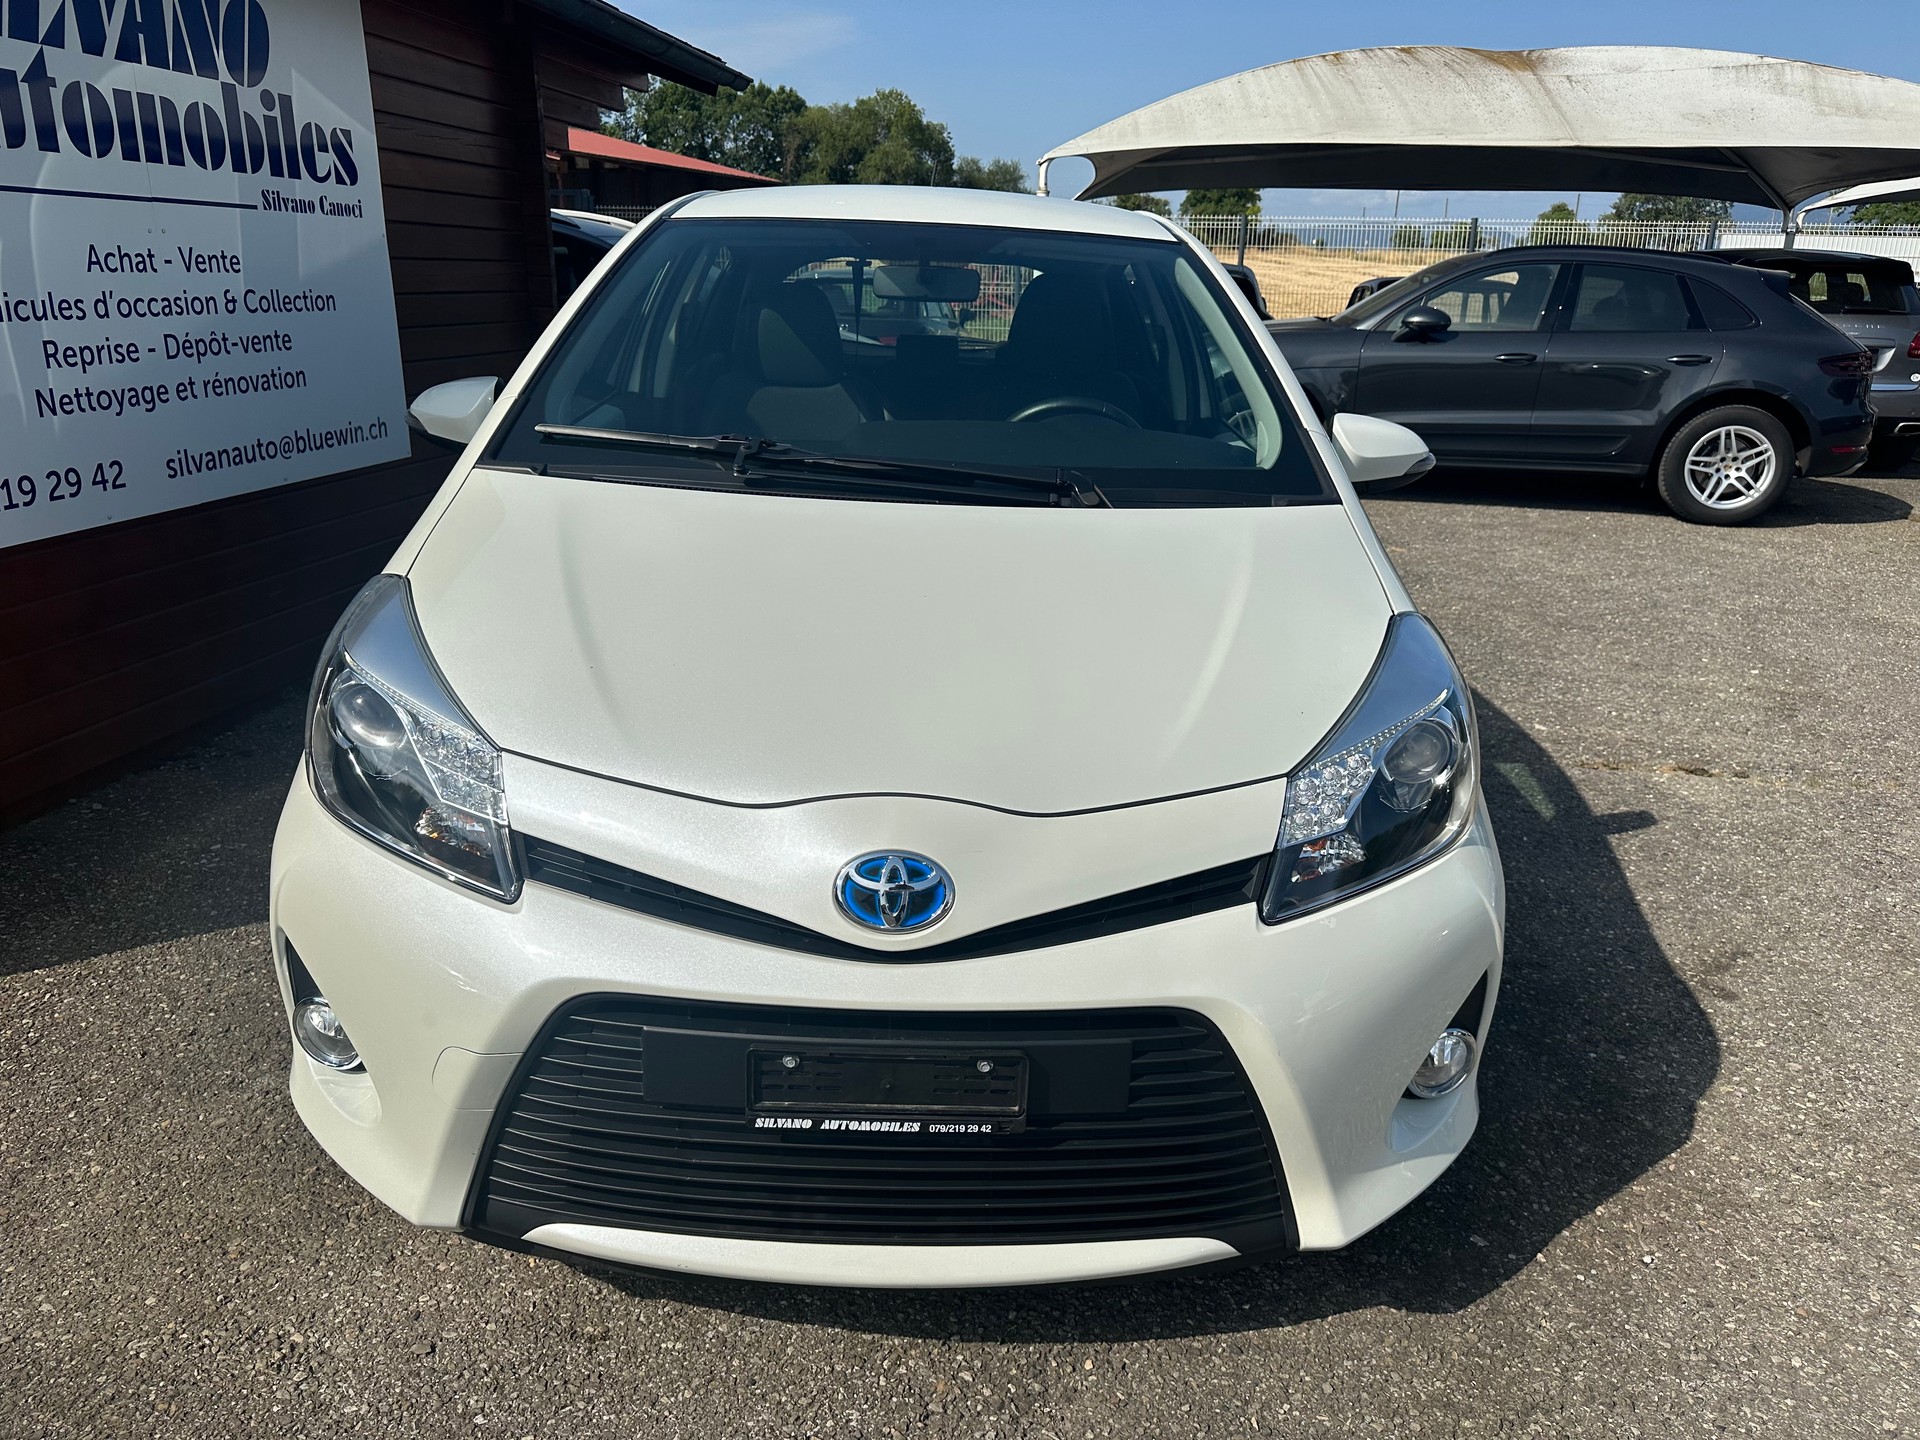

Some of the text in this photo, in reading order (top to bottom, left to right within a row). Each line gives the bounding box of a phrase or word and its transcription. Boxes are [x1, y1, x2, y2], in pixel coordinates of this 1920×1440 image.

[0, 0, 270, 88] LVANO
[260, 188, 363, 219] Silvano Canoci
[86, 243, 158, 274] Achat
[176, 246, 242, 274] Vente
[0, 288, 337, 323] icules d'occasion & Collection
[41, 336, 141, 375] Reprise
[162, 329, 293, 365] Dépôt-vente
[34, 366, 307, 419] Nettoyage et rénovation
[165, 416, 388, 479] silvanauto@bluewin.ch
[0, 459, 127, 513] 19 29 42
[754, 1117, 992, 1133] SILVANO AUTOMOBILES 079/219 29 42
